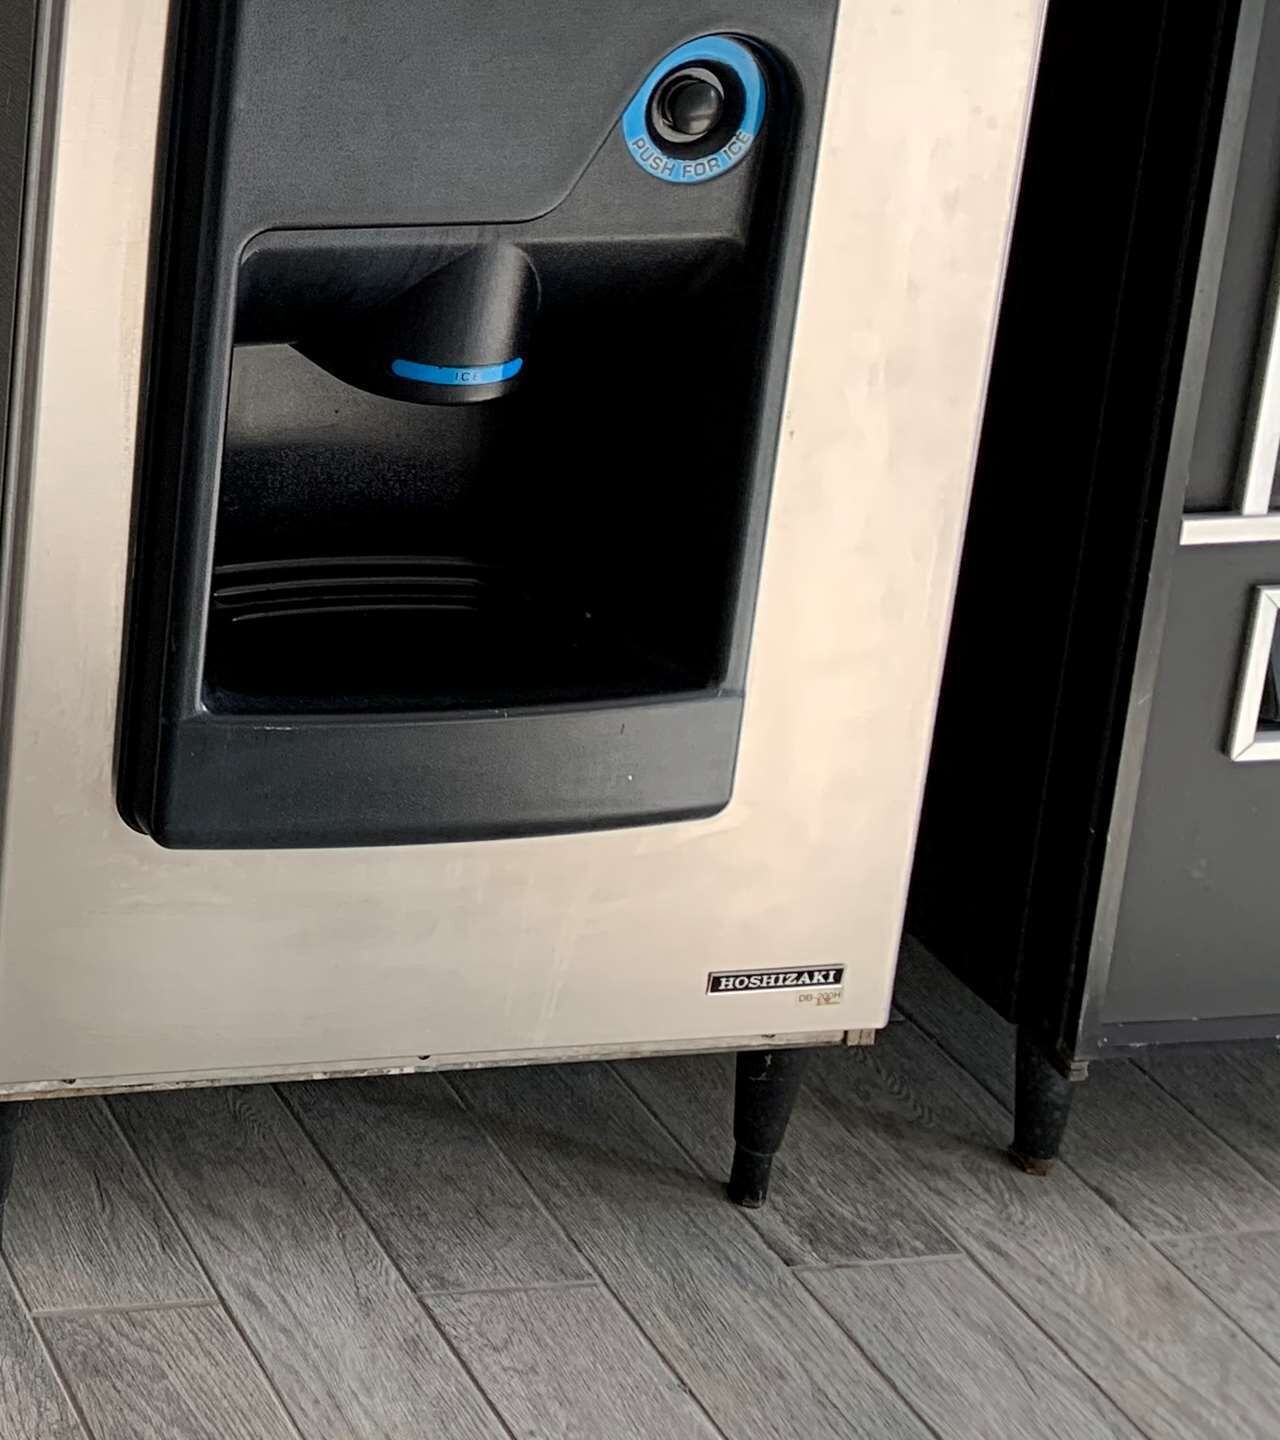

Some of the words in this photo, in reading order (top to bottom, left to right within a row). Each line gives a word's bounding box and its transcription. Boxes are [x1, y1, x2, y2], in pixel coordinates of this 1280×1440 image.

[631, 136, 676, 177] PUSH
[681, 157, 721, 178] FOR
[722, 128, 752, 161] ICE
[718, 970, 837, 990] HOSHIZAKI
